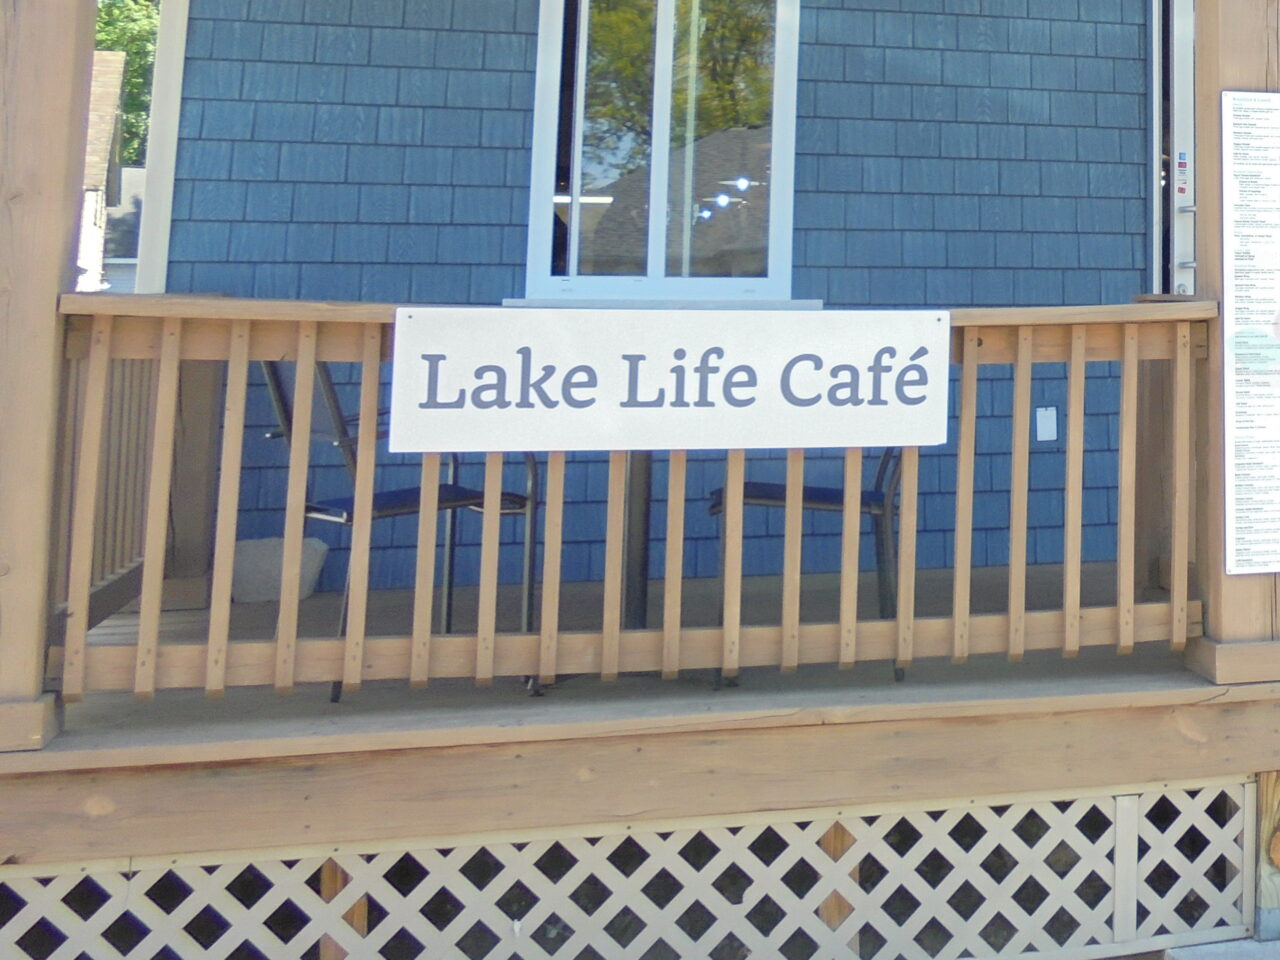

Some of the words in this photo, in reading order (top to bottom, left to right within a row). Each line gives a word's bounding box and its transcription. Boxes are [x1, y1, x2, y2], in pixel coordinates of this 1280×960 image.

[418, 345, 598, 409] Lake
[619, 346, 758, 408] Life
[779, 345, 930, 407] Café
